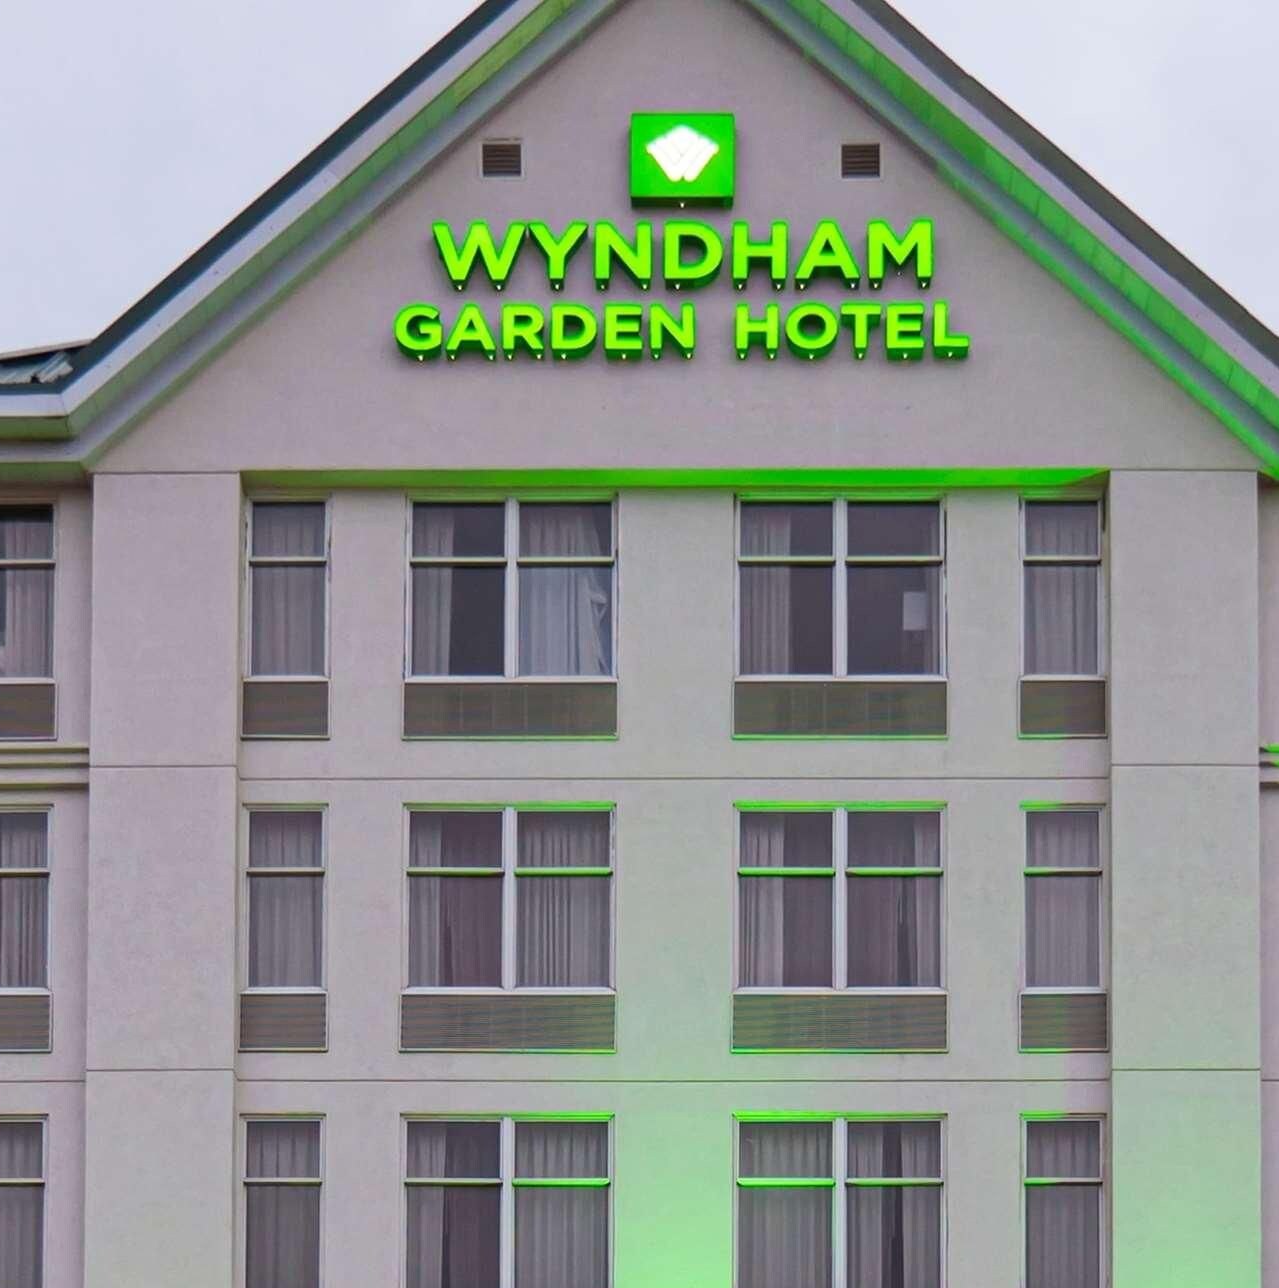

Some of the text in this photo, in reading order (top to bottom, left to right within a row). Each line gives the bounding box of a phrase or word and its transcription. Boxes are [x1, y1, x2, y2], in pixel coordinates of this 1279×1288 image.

[432, 220, 934, 290] WYNDHAM
[393, 303, 969, 359] GARDEN HOTEL
